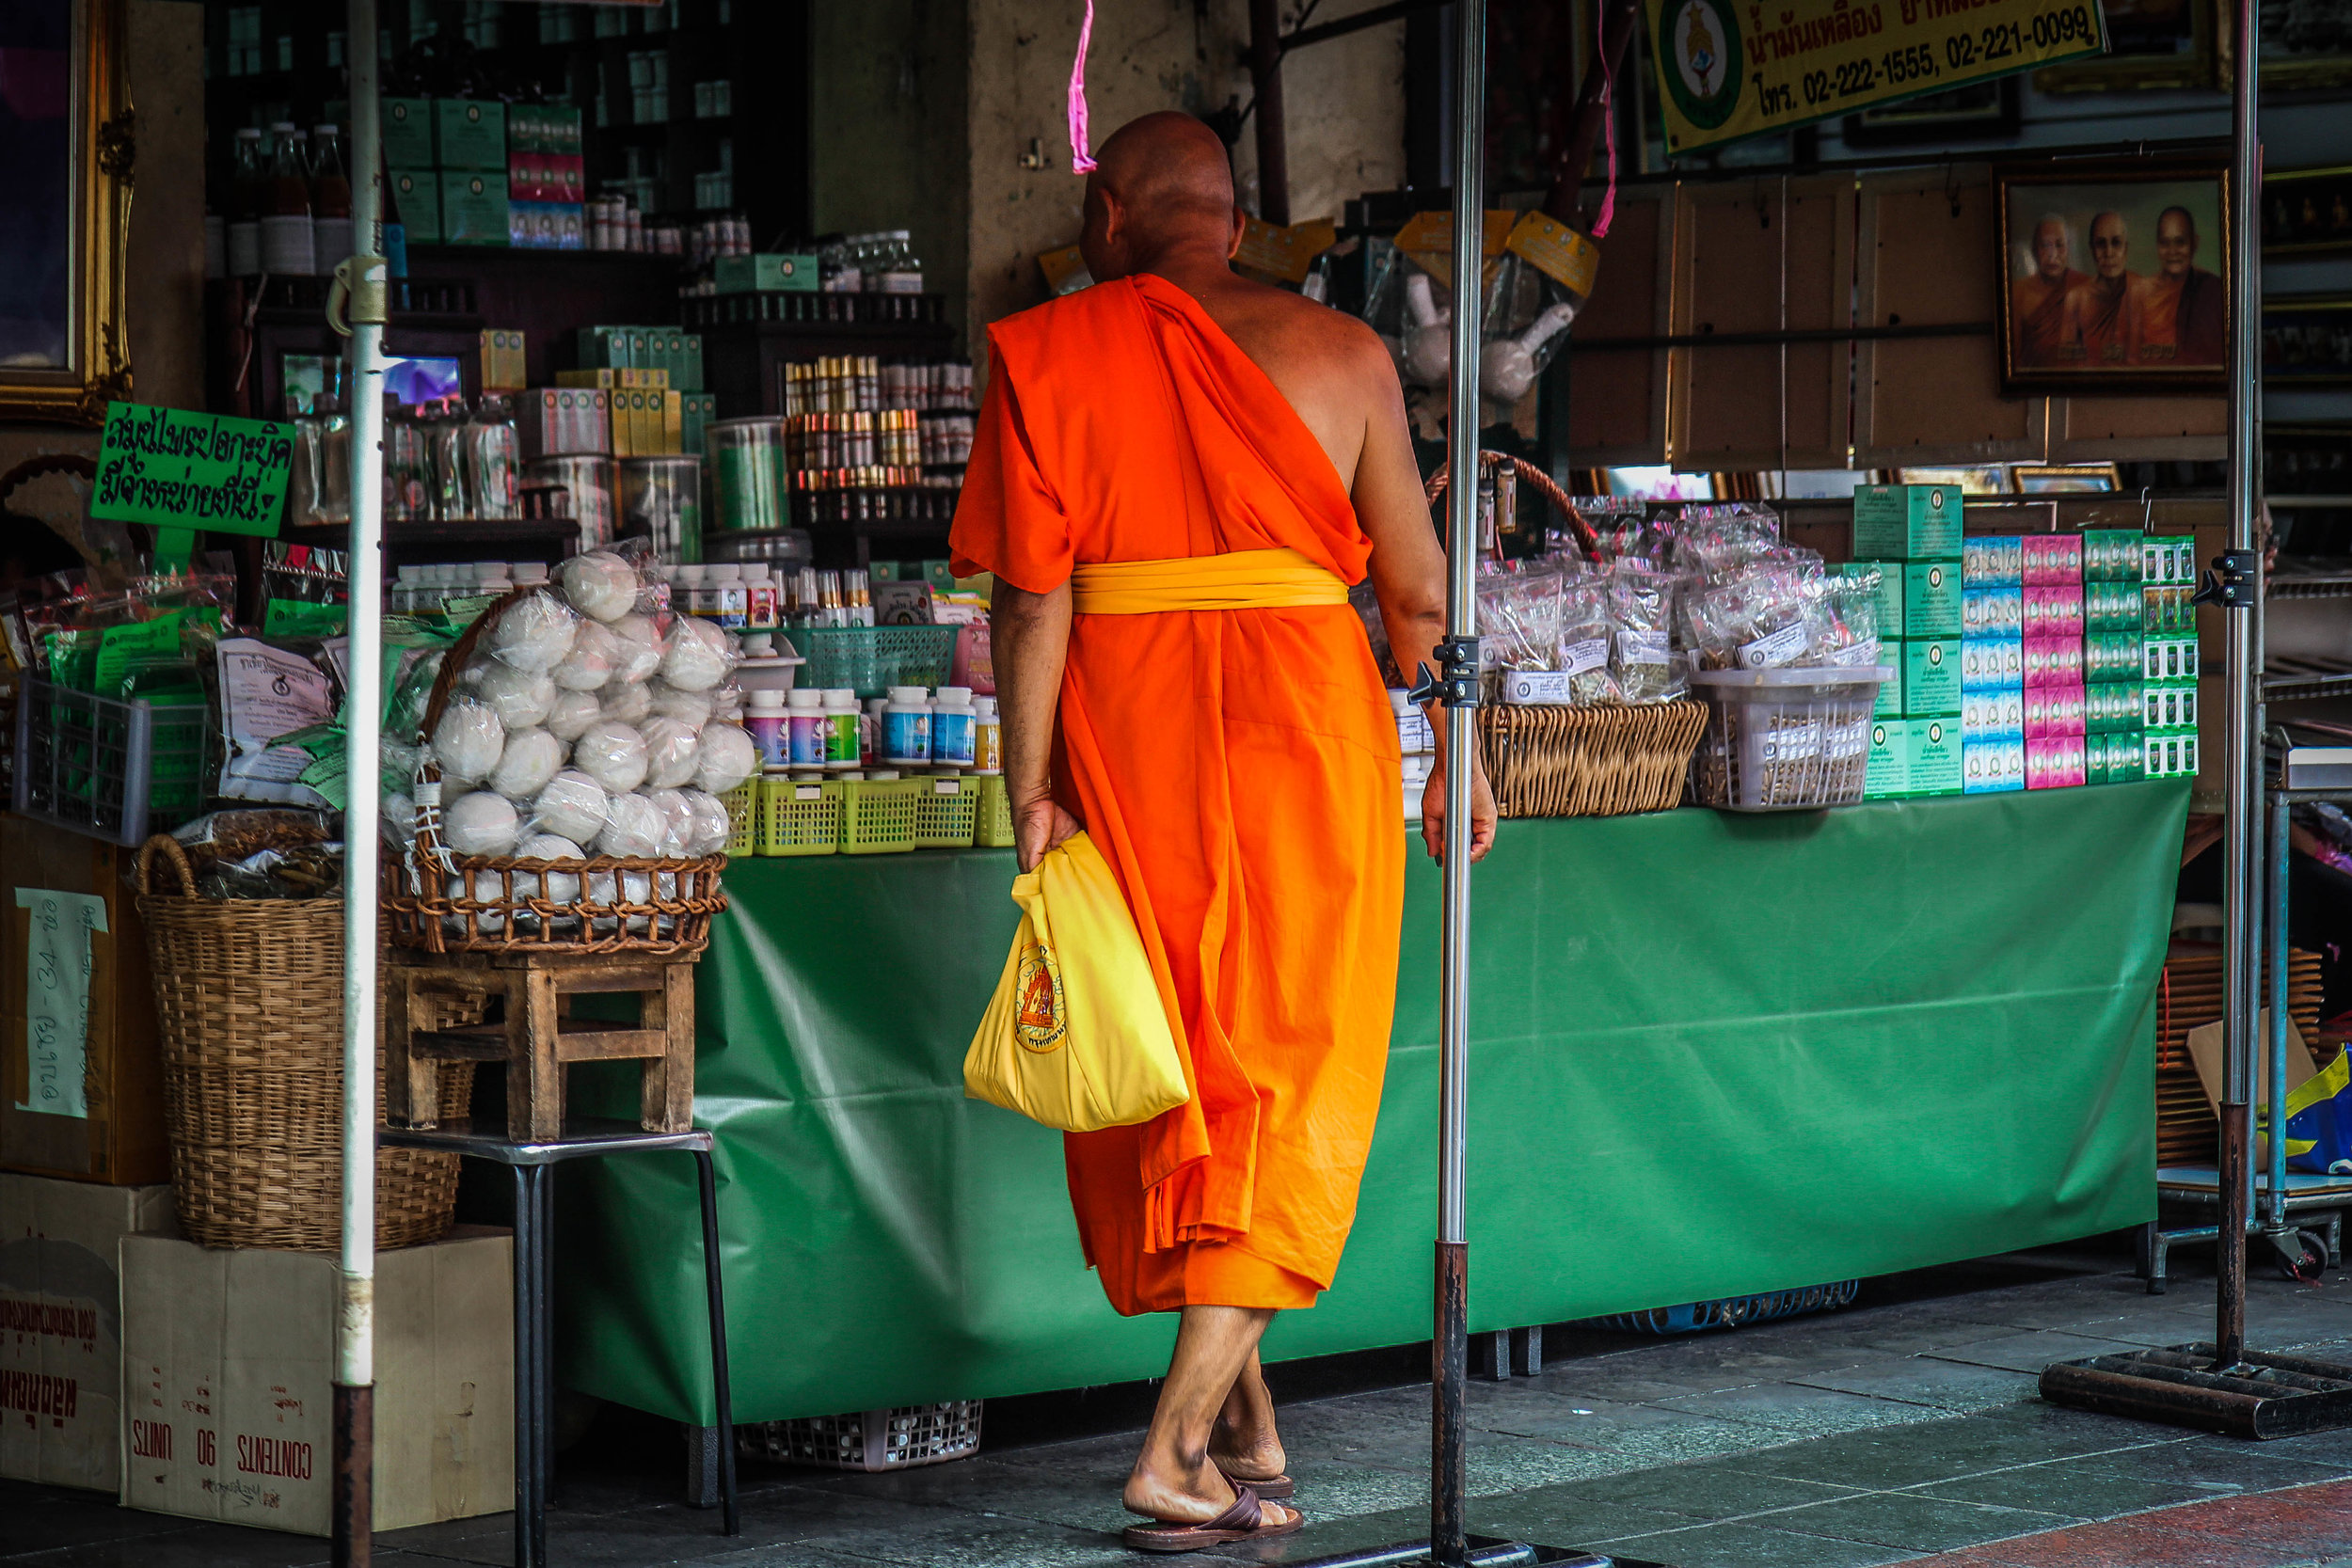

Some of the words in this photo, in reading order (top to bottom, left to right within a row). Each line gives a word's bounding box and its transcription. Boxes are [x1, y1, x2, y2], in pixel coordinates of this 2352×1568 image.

[1747, 0, 1882, 65] น้ำมันเหลือง
[1752, 72, 1796, 117] โทร.
[1803, 44, 1939, 104] 02-222-1555,
[1947, 7, 2089, 69] 02-221-0099
[134, 1418, 172, 1462] UNITS
[197, 1428, 216, 1467] 90
[237, 1434, 312, 1481] CONTENTS
